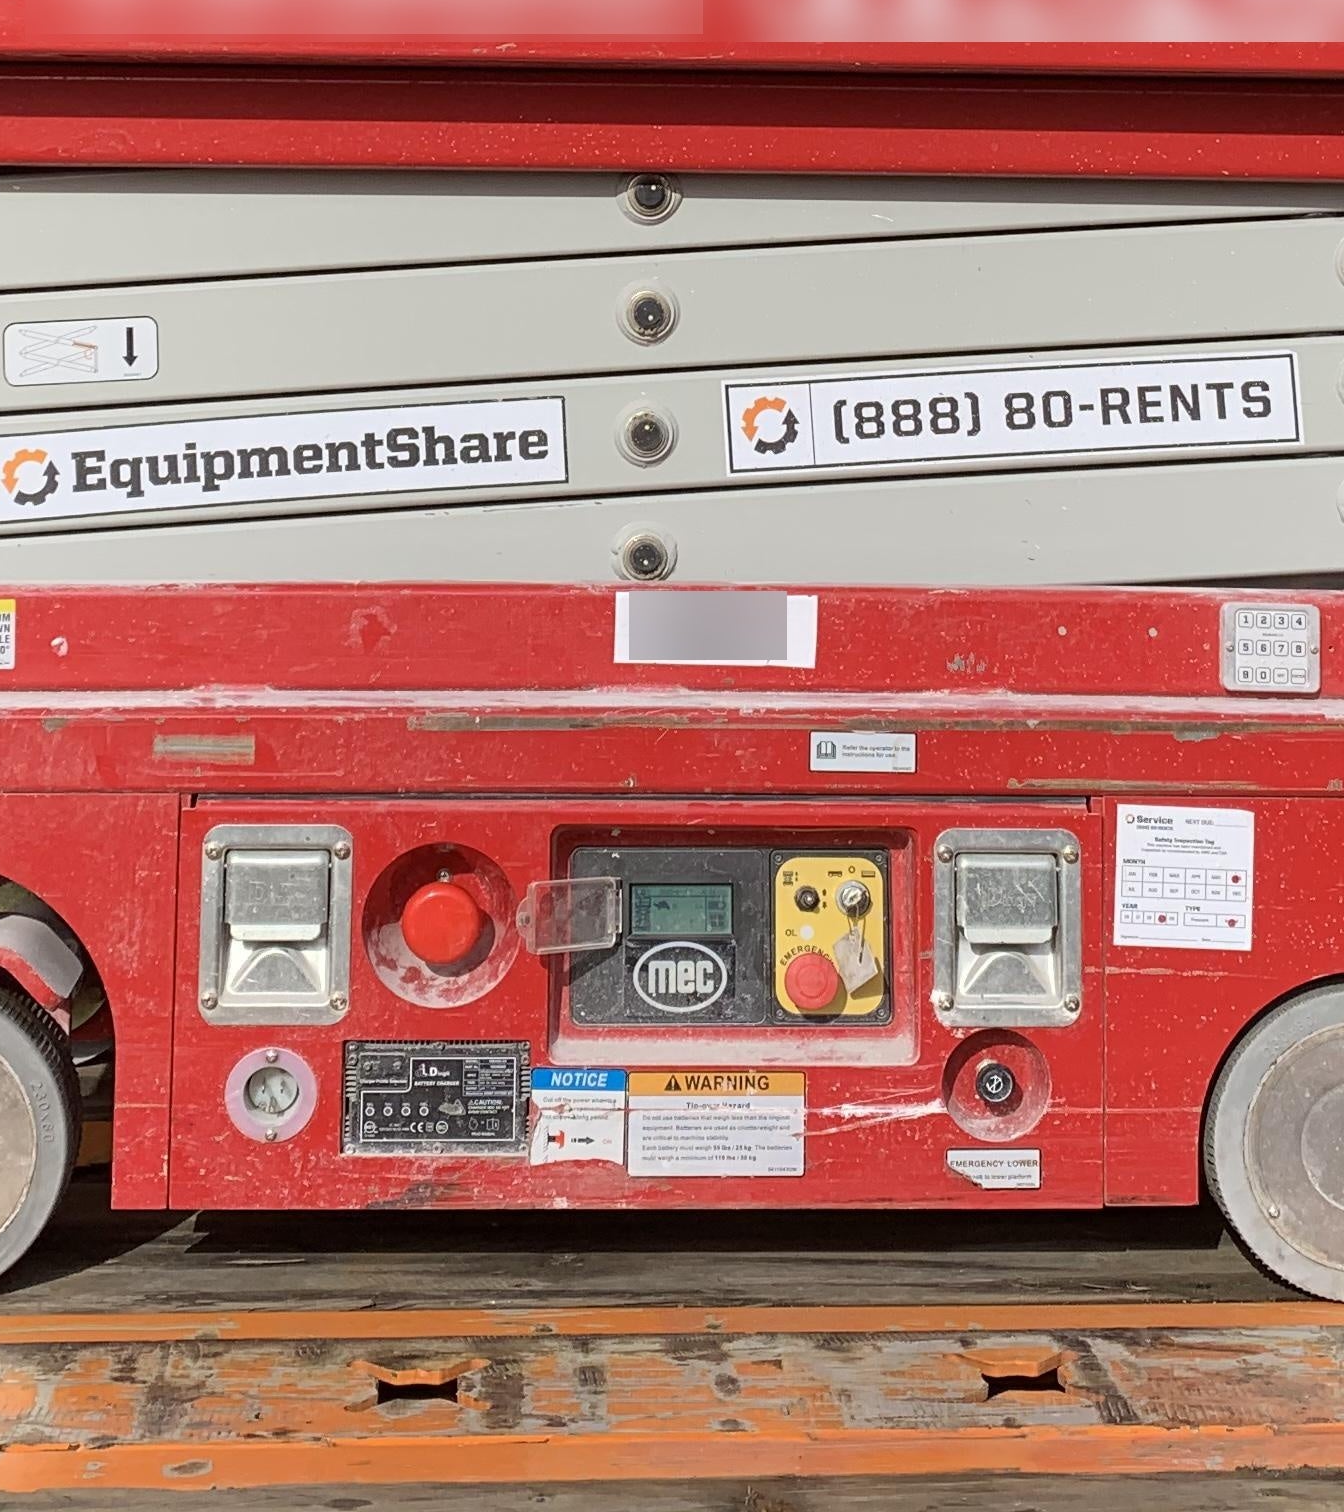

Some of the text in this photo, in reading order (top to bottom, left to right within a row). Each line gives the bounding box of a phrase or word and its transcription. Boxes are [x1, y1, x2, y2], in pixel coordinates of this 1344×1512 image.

[833, 380, 1272, 444] (888) 80-RENTS
[71, 425, 549, 498] EquipmentShare
[1243, 615, 1302, 626] 1 2 3 4
[1243, 643, 1302, 653] 5 6 7 8
[1243, 670, 1249, 679] 9
[1261, 671, 1266, 679] 0
[1136, 815, 1173, 824] Service
[648, 960, 714, 994] mec
[550, 1072, 608, 1087] NOTICE
[684, 1075, 769, 1091] WARNING
